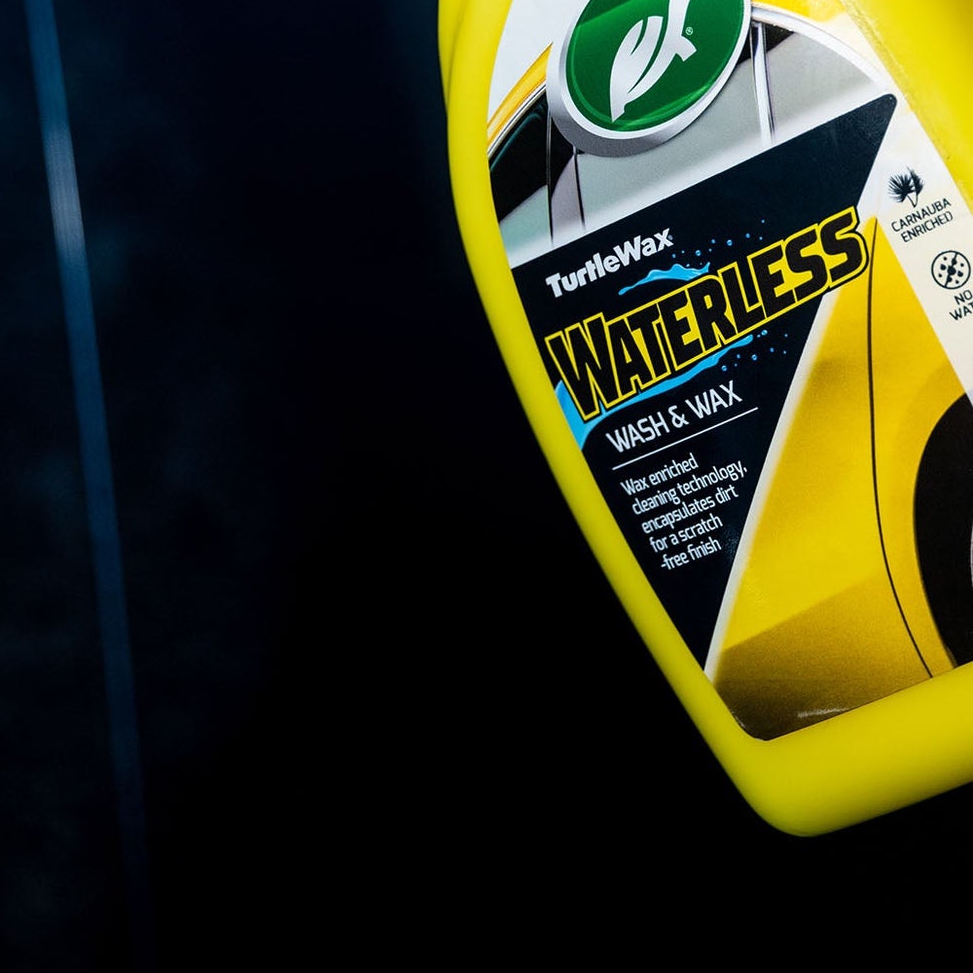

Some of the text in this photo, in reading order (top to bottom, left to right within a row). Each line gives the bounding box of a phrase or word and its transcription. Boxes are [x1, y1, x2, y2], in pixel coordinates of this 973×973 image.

[891, 198, 952, 232] CARNAUBA
[901, 211, 954, 243] ENRICHED
[544, 206, 869, 421] WATERLESS
[954, 289, 973, 305] NO
[605, 380, 743, 453] WASH & WAX
[620, 453, 699, 496] Wax enriched
[632, 460, 748, 515] cleaning technology,
[641, 484, 739, 534] encapsulates dirt
[649, 513, 723, 553] for a scratch
[661, 537, 722, 570] -free finish
